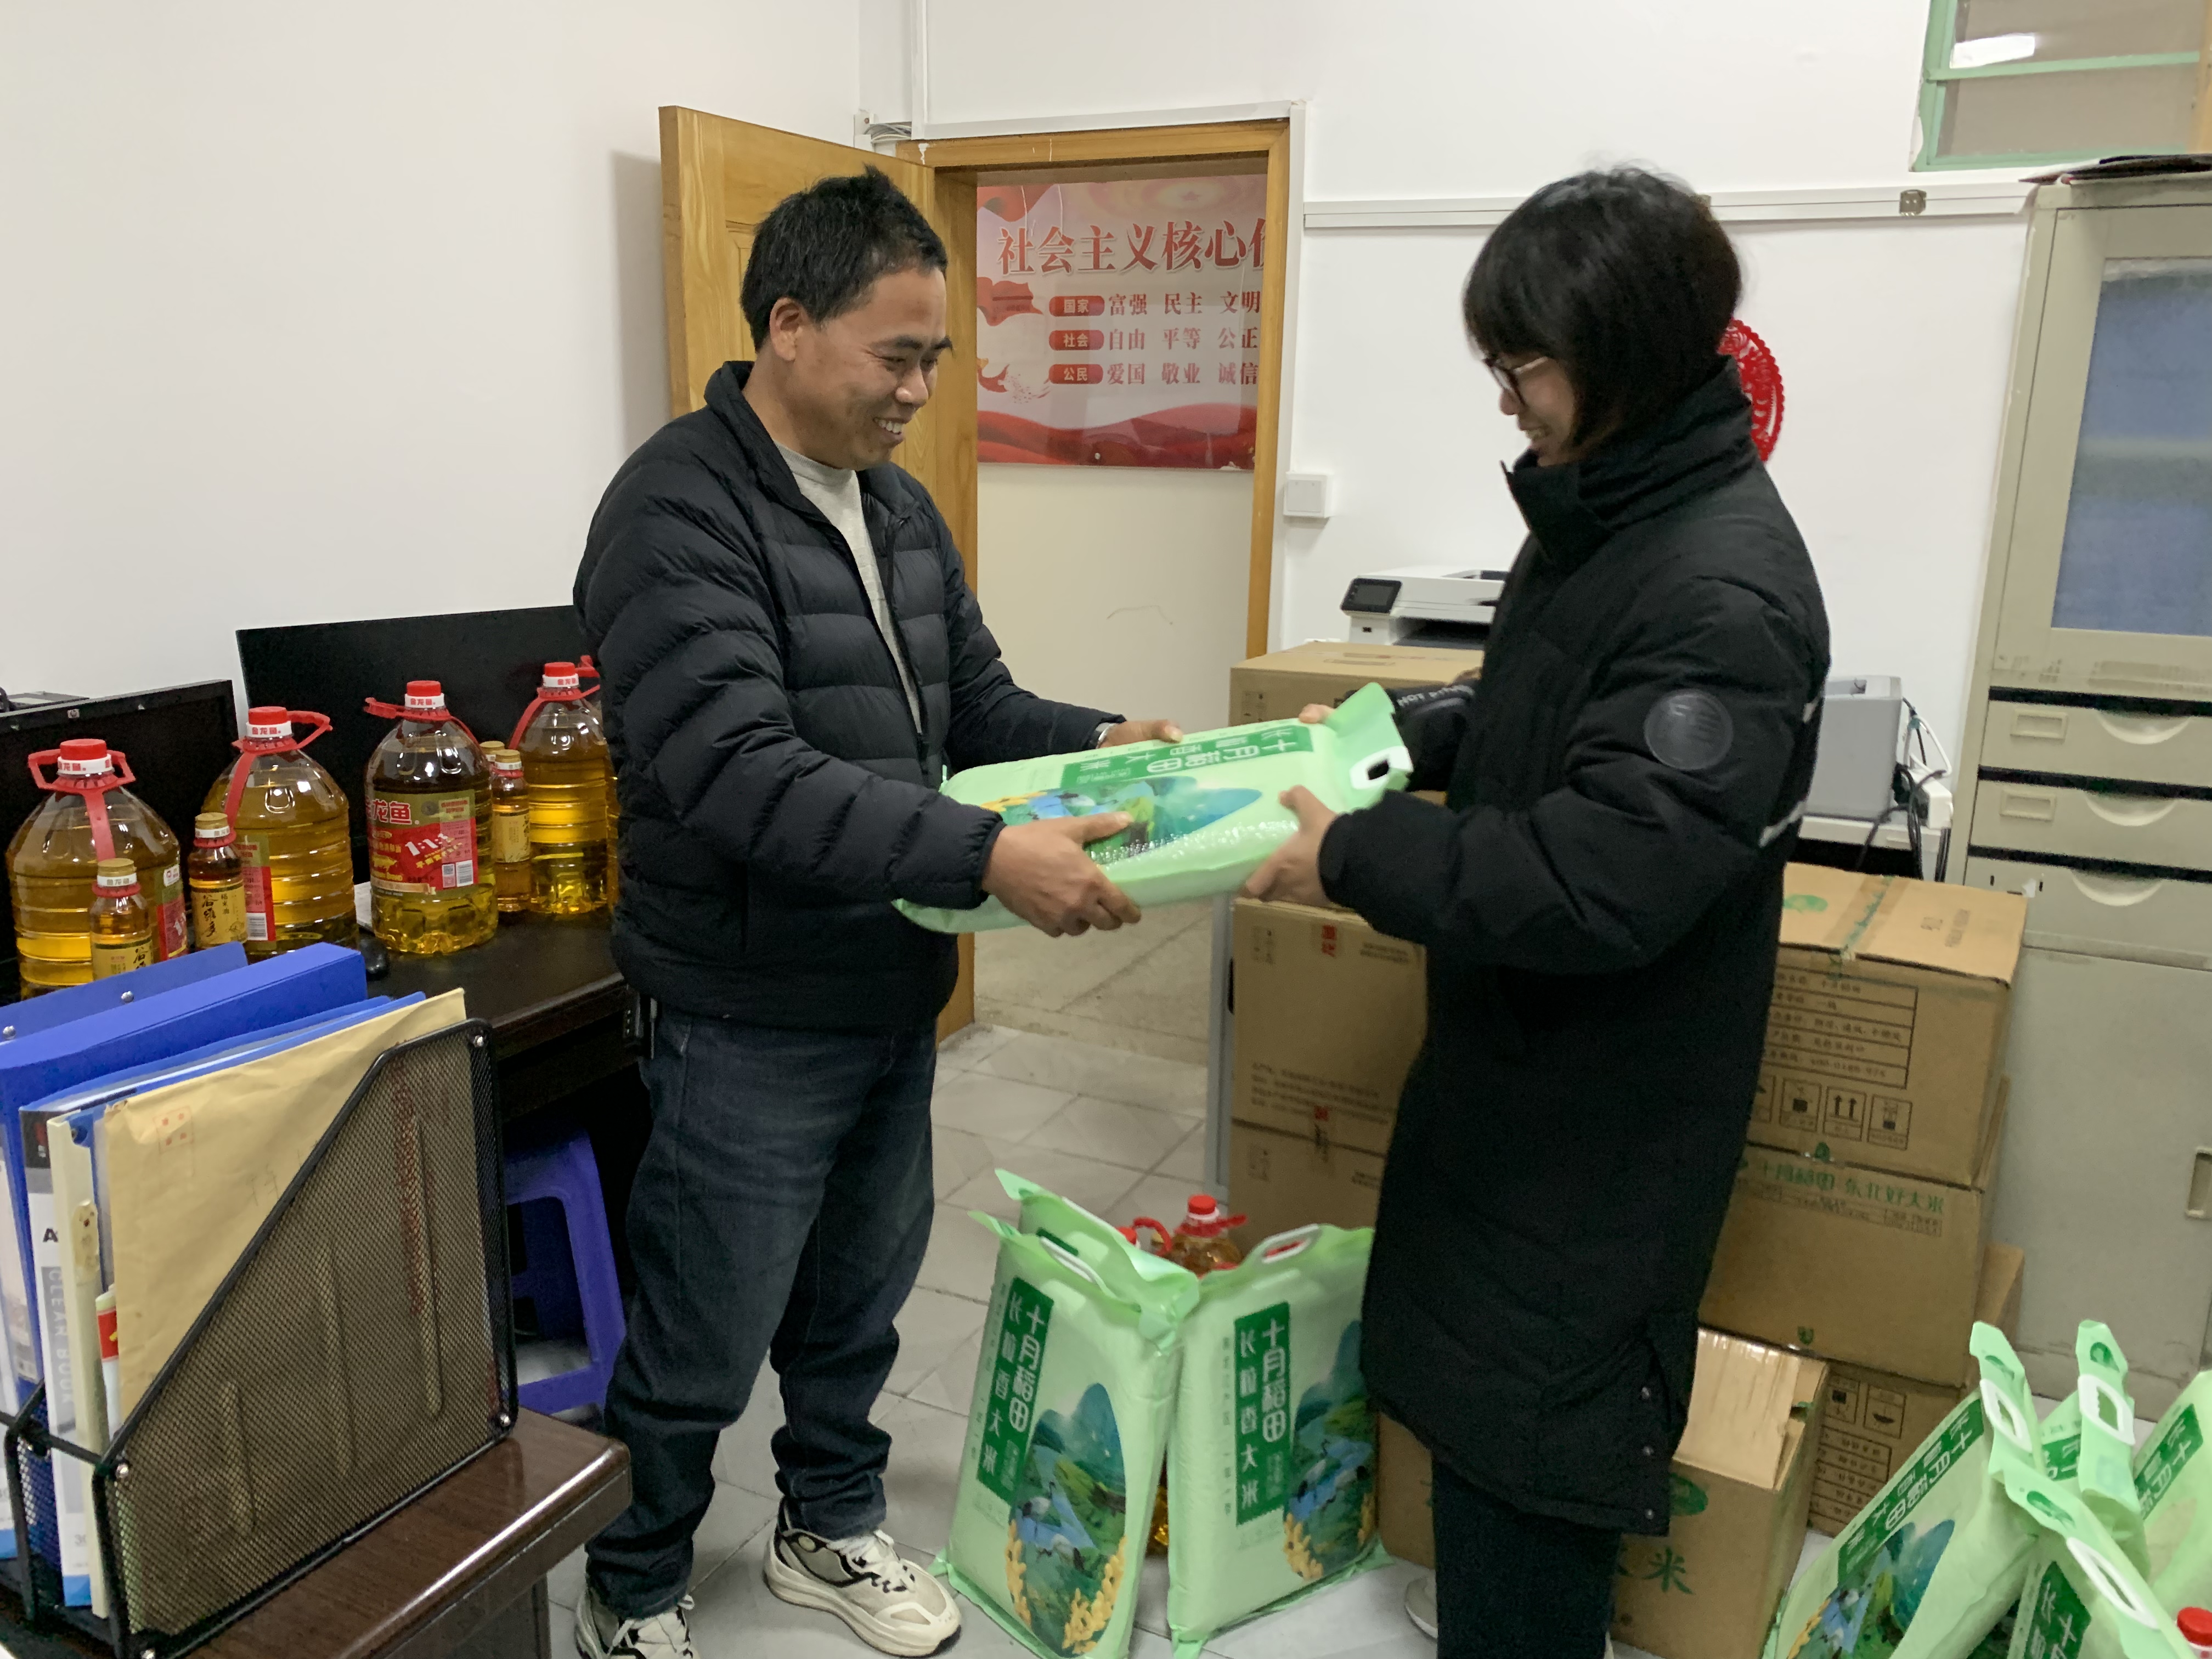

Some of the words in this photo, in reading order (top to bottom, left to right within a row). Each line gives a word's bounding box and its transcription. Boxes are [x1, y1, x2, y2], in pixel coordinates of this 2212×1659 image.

[1063, 299, 1090, 314] 国家
[1108, 293, 1148, 317] 富强
[1164, 292, 1203, 315] 民主
[1219, 291, 1261, 315] 文明
[1063, 332, 1089, 348] 社会
[1109, 328, 1146, 350] 自由
[1161, 327, 1201, 350] 平等
[1217, 327, 1258, 349] 公正
[1063, 366, 1088, 381] 公民
[1107, 363, 1146, 385] 爱国
[1161, 362, 1200, 385] 敬业
[1218, 362, 1259, 385] 诚信
[1008, 1304, 1045, 1433] 十月稻田
[1262, 1318, 1286, 1443] 十月稻田
